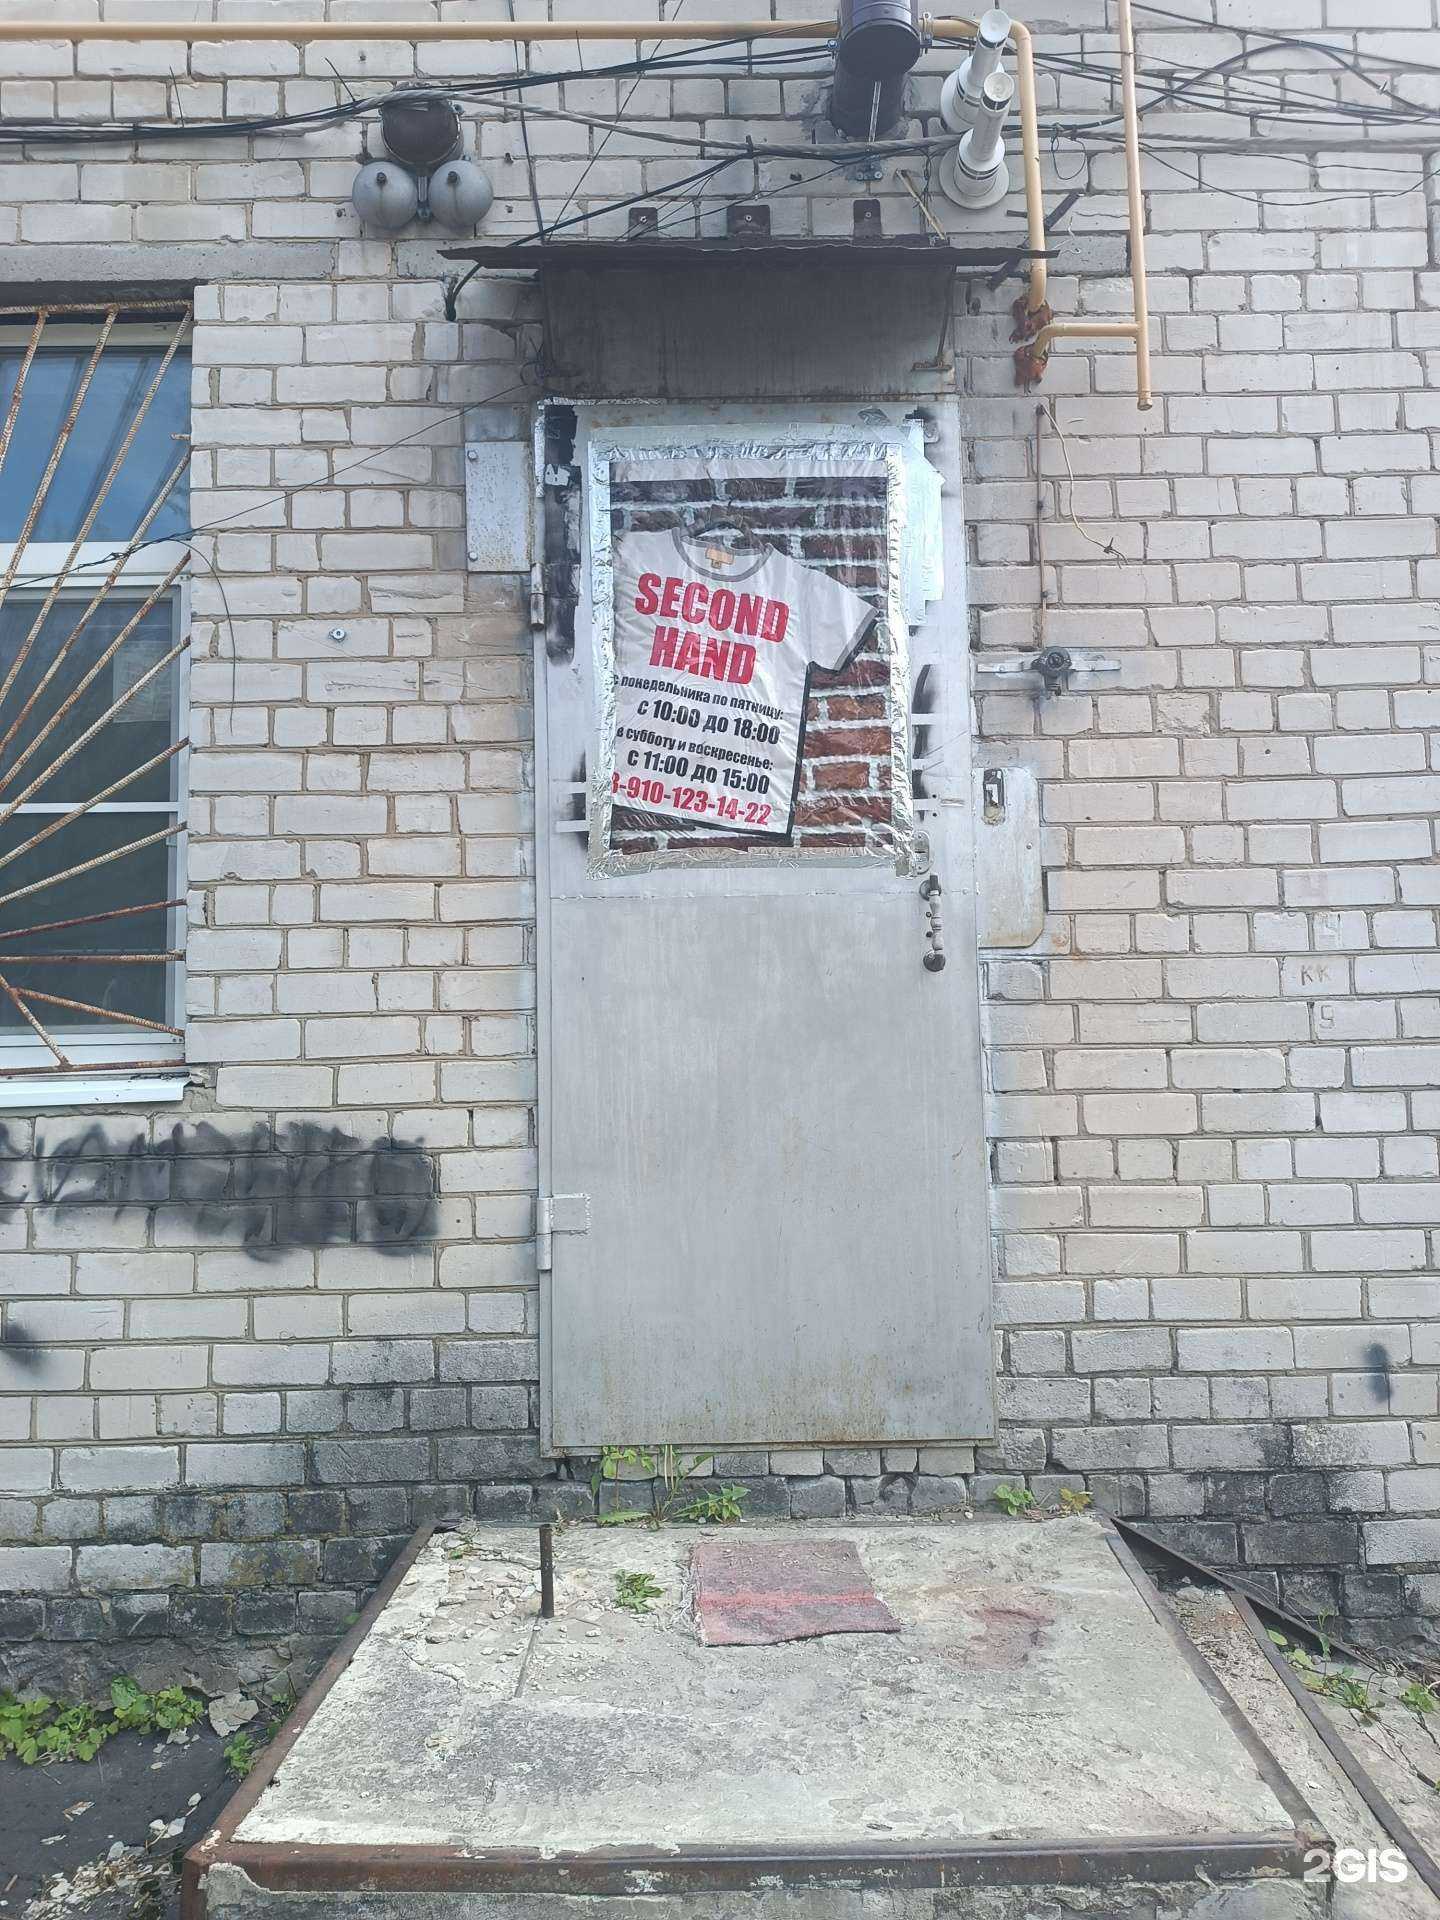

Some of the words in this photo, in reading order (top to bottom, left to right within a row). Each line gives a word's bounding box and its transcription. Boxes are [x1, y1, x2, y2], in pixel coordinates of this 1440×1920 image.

[635, 572, 790, 643] SECOND
[649, 625, 757, 685] HAND
[621, 675, 711, 704] понедельника
[712, 692, 728, 706] по
[730, 697, 784, 720] пятницу:
[653, 699, 701, 728] 10:00
[702, 714, 729, 734] до
[733, 717, 781, 745] 18:00
[616, 727, 624, 737] в
[625, 728, 677, 751] субботу
[676, 739, 687, 752] и
[688, 742, 774, 770] воскресенье:
[643, 750, 689, 778] 11:00
[690, 764, 718, 784] до
[722, 768, 771, 795] 15:00
